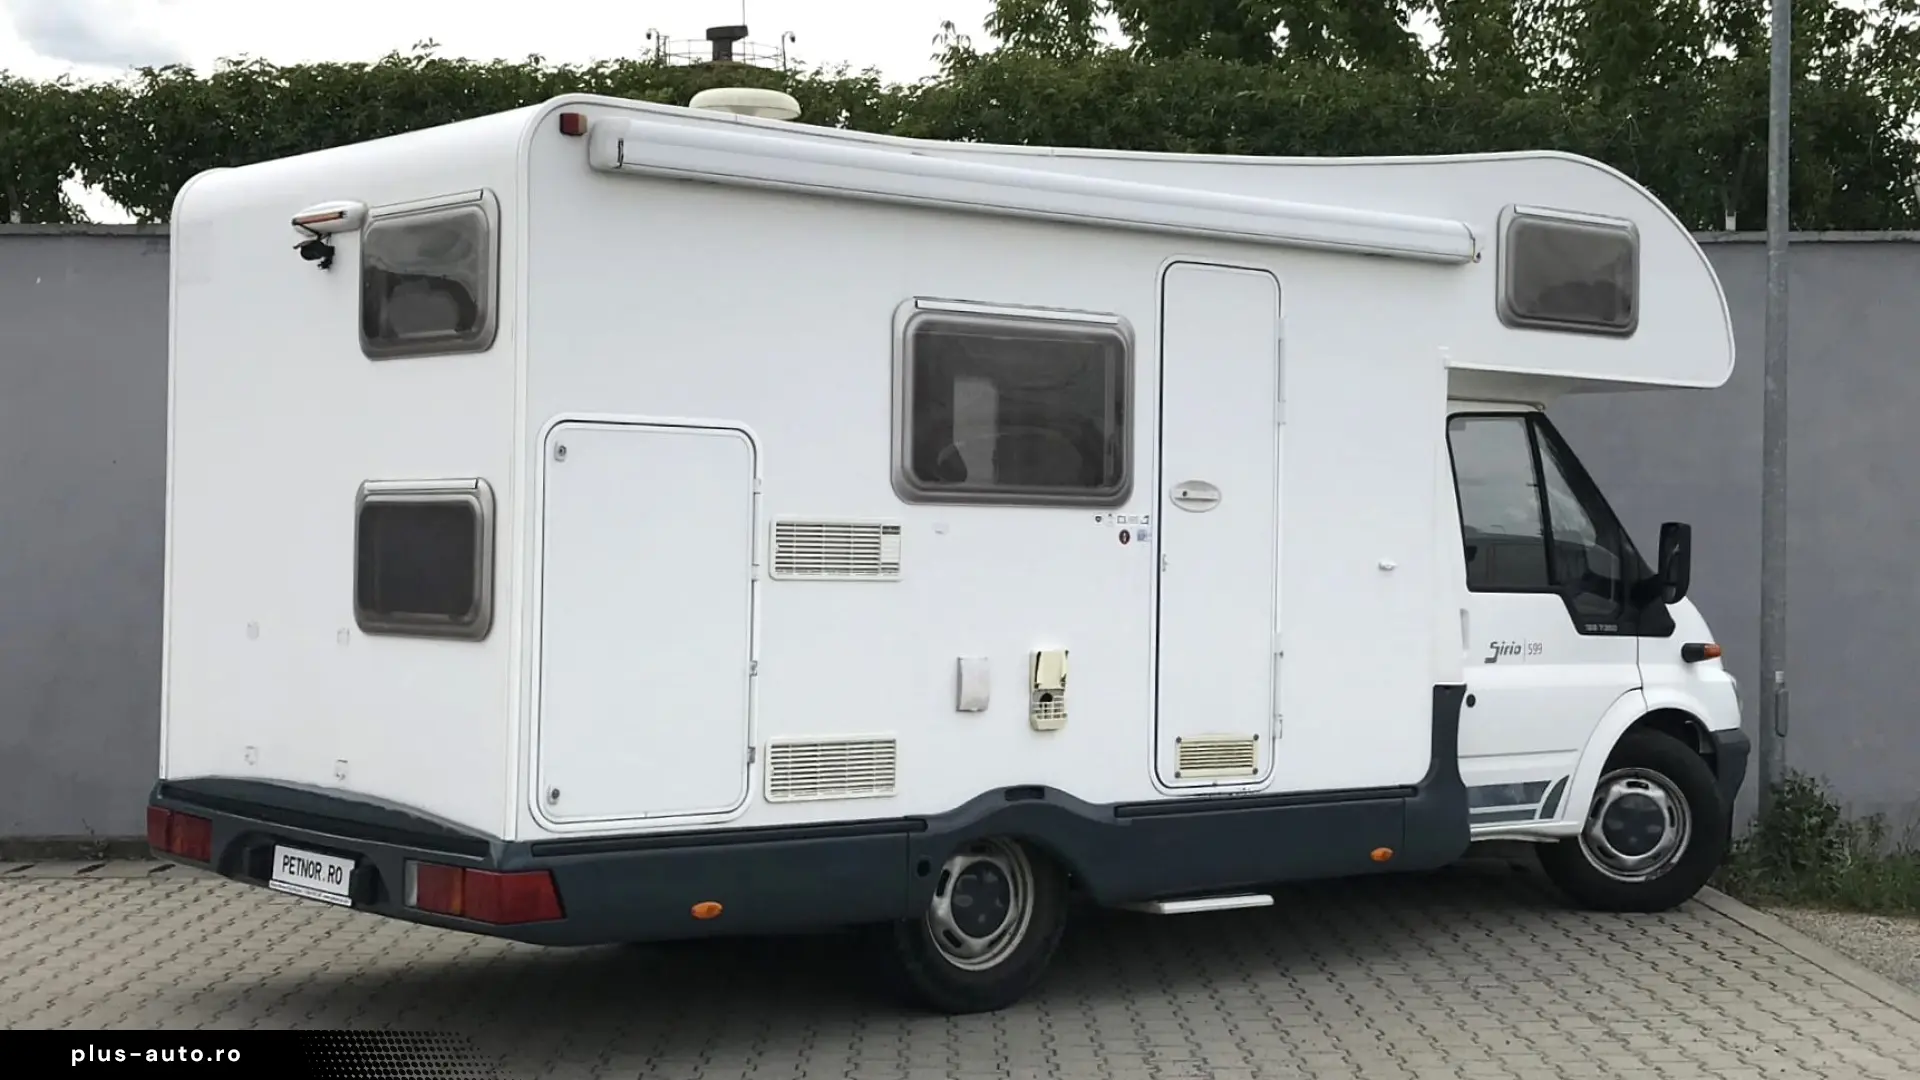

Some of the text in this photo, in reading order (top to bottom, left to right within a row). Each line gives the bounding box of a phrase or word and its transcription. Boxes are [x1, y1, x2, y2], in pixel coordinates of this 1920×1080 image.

[1484, 641, 1543, 664] Sirio 599
[282, 854, 343, 885] PETNOR.RO
